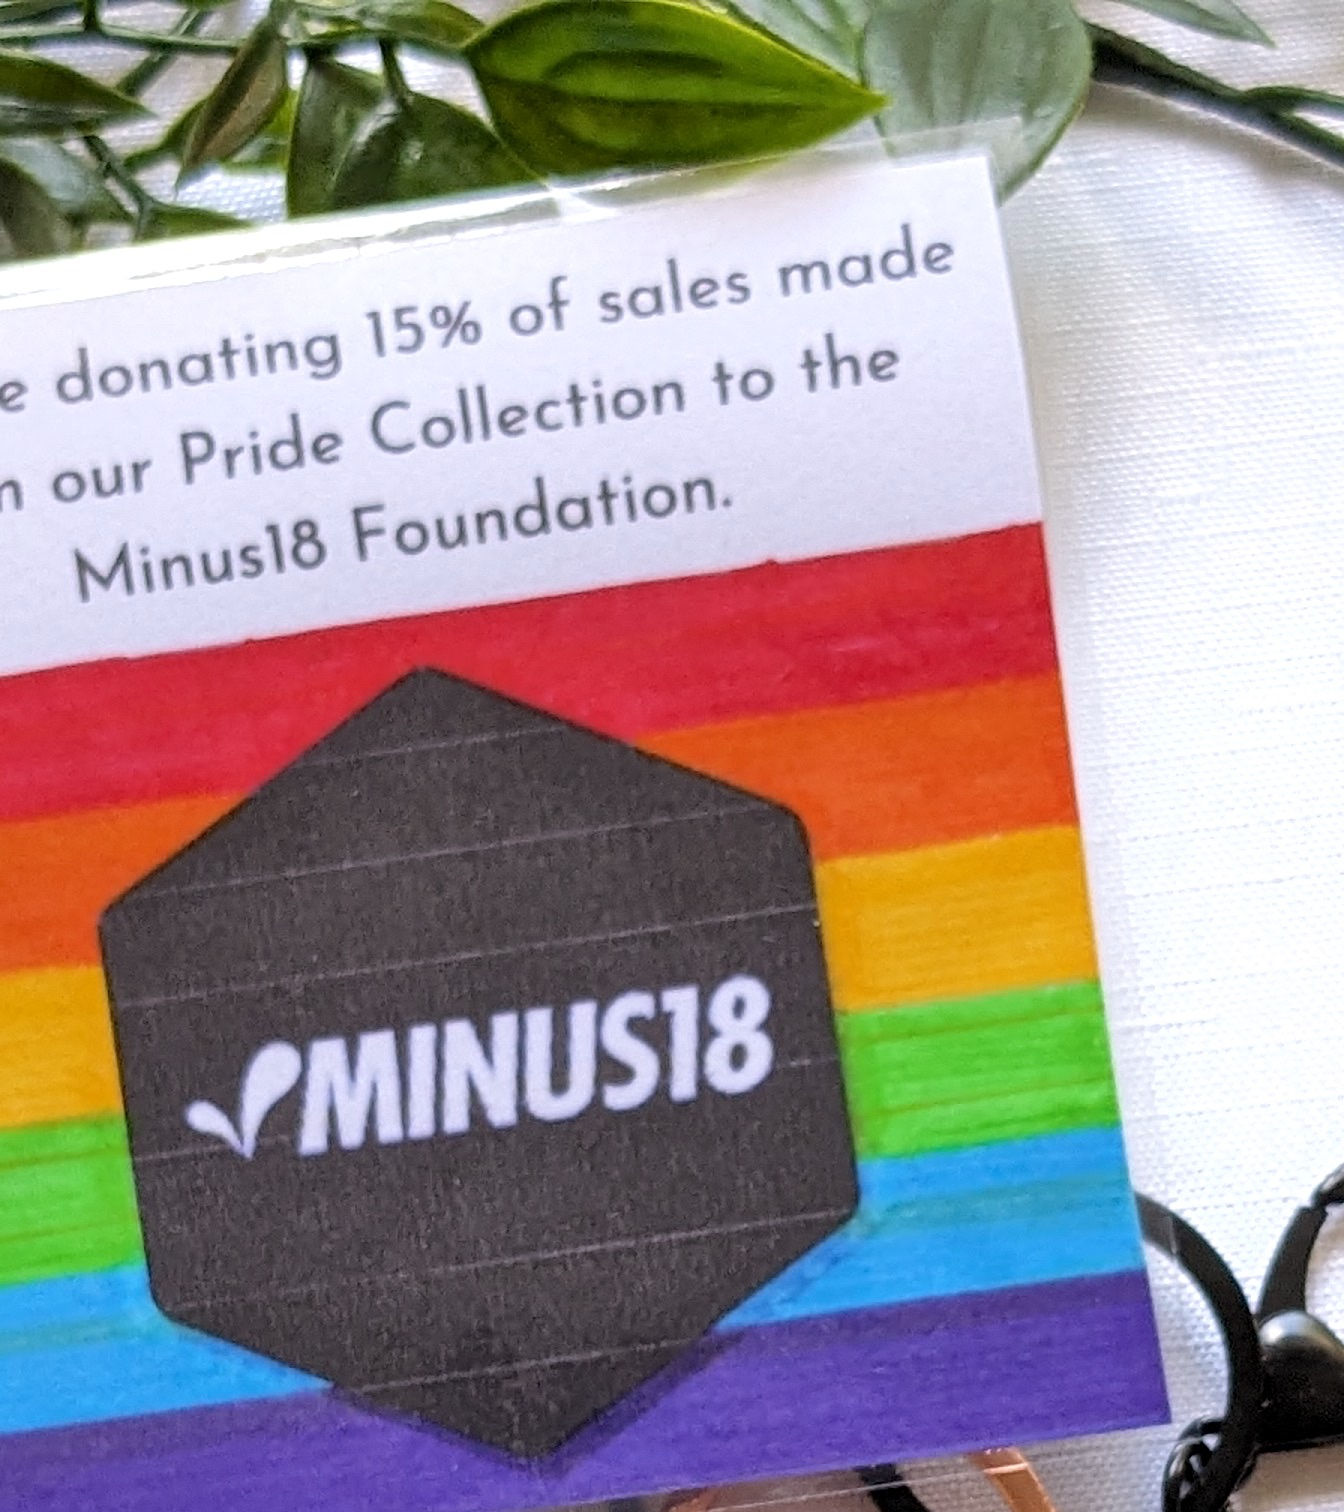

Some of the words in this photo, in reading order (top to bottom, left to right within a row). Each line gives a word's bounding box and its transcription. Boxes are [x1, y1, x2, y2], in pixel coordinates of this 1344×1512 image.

[55, 333, 342, 404] donating
[366, 301, 482, 357] 15%
[509, 275, 570, 336] of
[599, 257, 751, 323] sales
[778, 223, 954, 297] made
[51, 459, 152, 503] our
[179, 412, 343, 485] Pride
[370, 379, 685, 454] Collection
[712, 361, 775, 405] to
[799, 332, 900, 393] the
[73, 518, 327, 603] Minus18
[351, 474, 734, 562] Foundation.
[295, 973, 775, 1157] MINUS18
